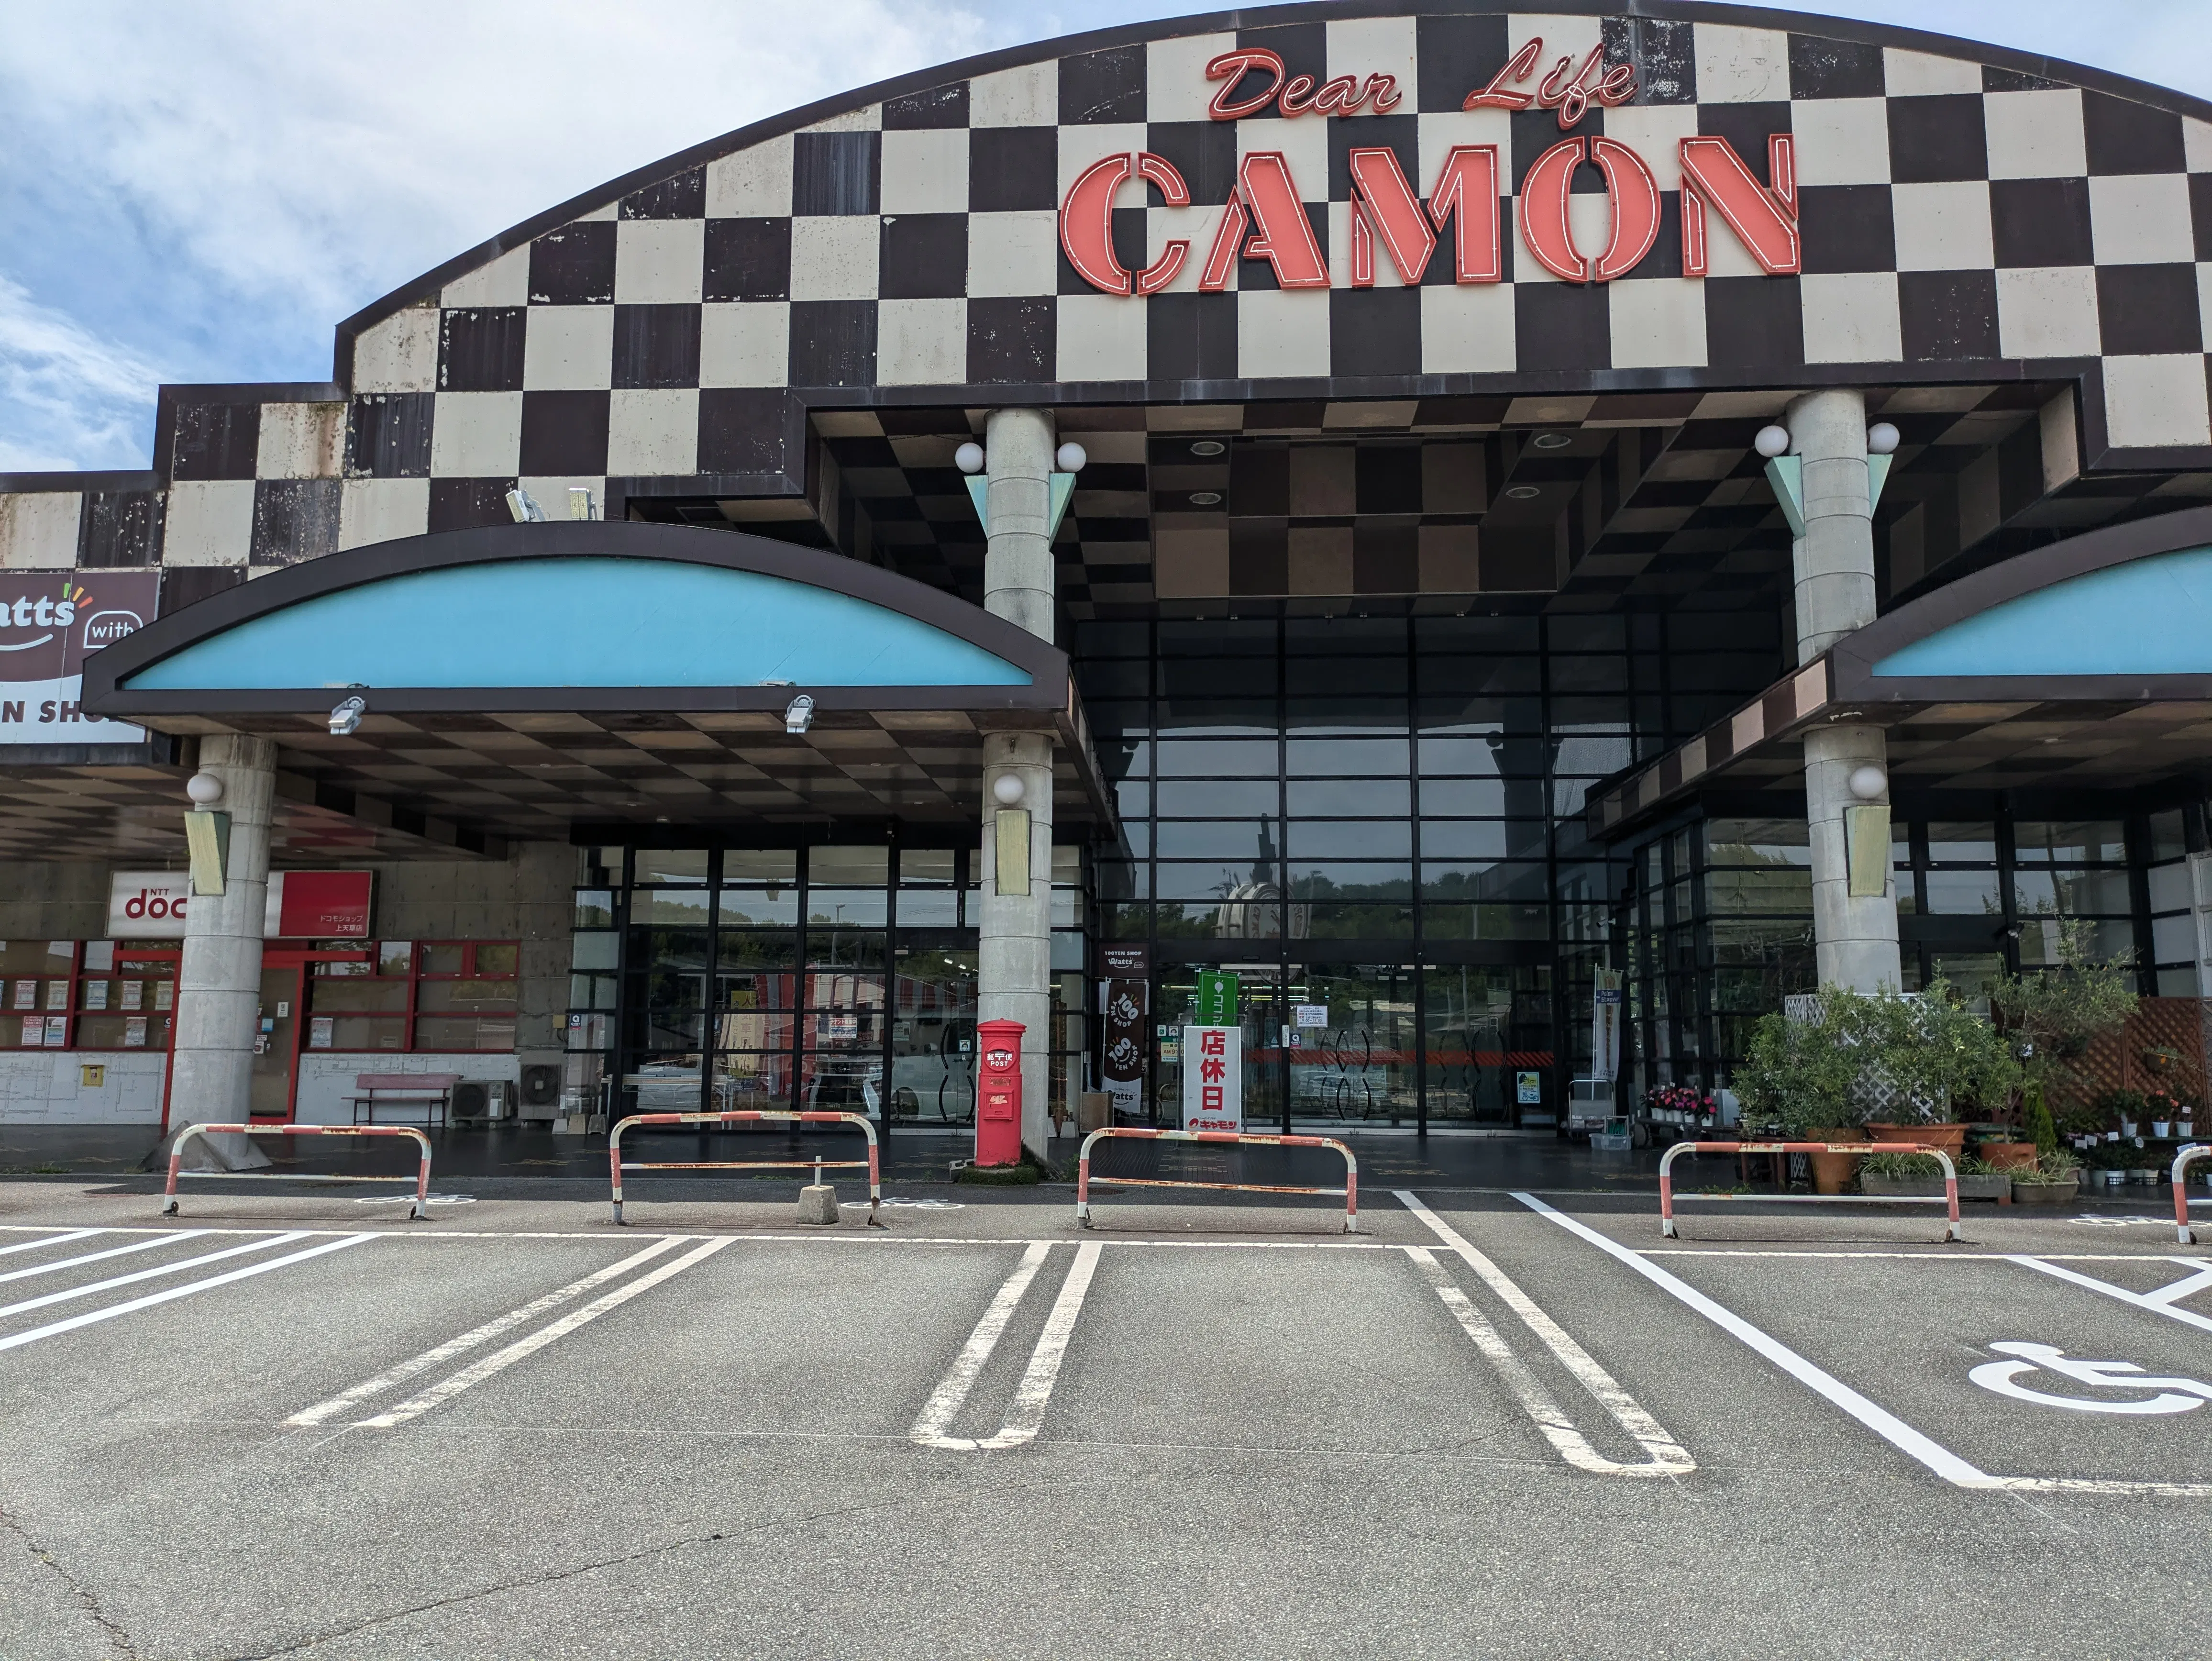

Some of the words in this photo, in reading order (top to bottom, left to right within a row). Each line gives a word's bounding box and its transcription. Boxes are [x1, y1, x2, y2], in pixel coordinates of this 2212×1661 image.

[1205, 48, 1402, 121] Dear
[1462, 36, 1640, 131] Life
[1060, 133, 1801, 297] CAMON
[1118, 993, 1139, 1019] 100
[1108, 1038, 1131, 1062] 100
[1200, 1030, 1226, 1111] 店休日
[1105, 1090, 1133, 1101] atts
[1200, 1119, 1237, 1130] キャモン
